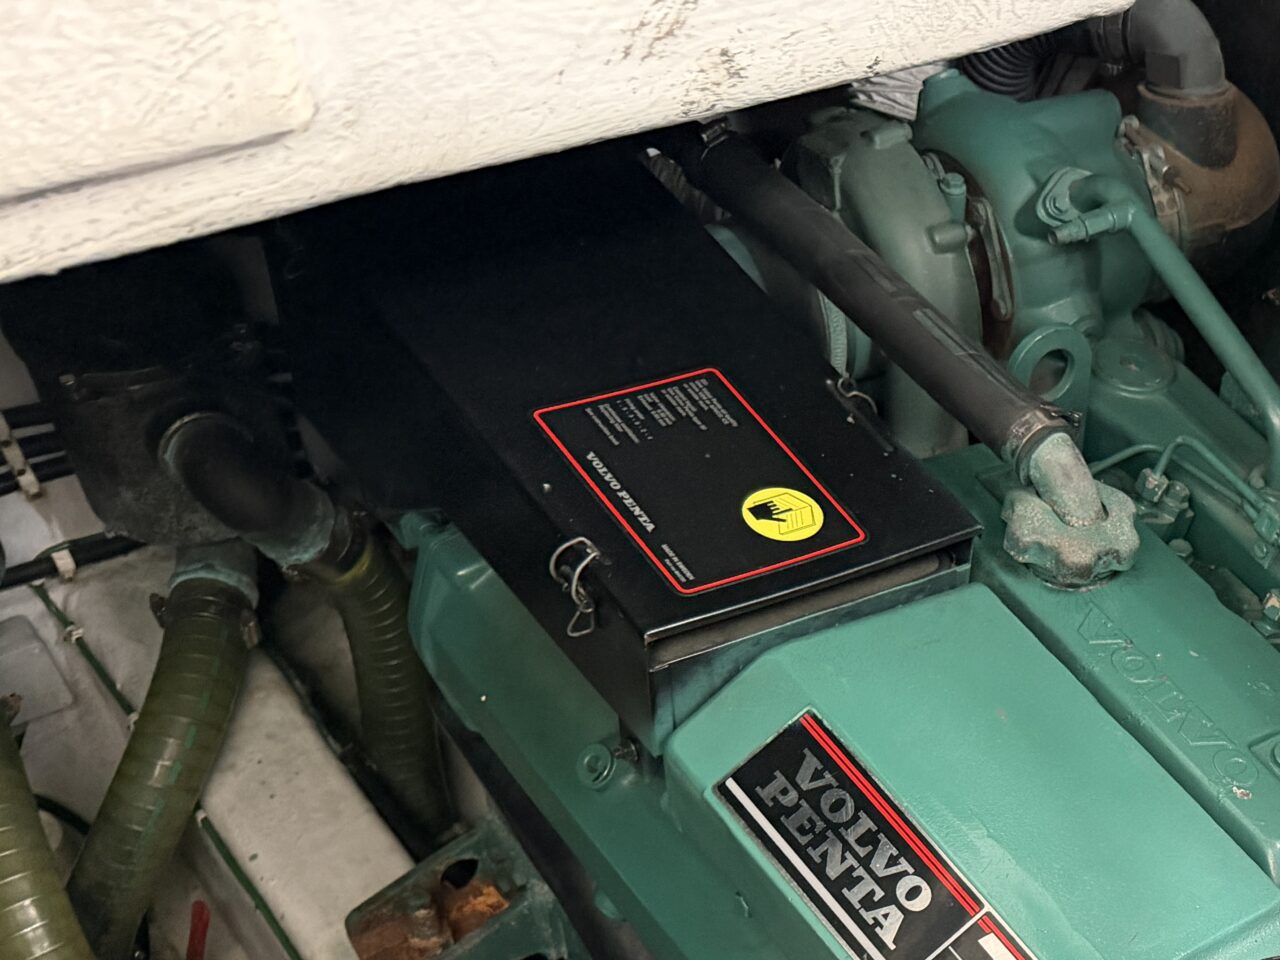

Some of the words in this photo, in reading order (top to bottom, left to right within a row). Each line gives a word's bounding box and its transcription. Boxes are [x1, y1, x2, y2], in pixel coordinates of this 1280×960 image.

[586, 451, 622, 490] VOLVO
[616, 490, 656, 533] PENTA
[1076, 599, 1259, 787] VOLVO
[755, 771, 905, 950] PENTA
[795, 749, 932, 913] VOLVO
